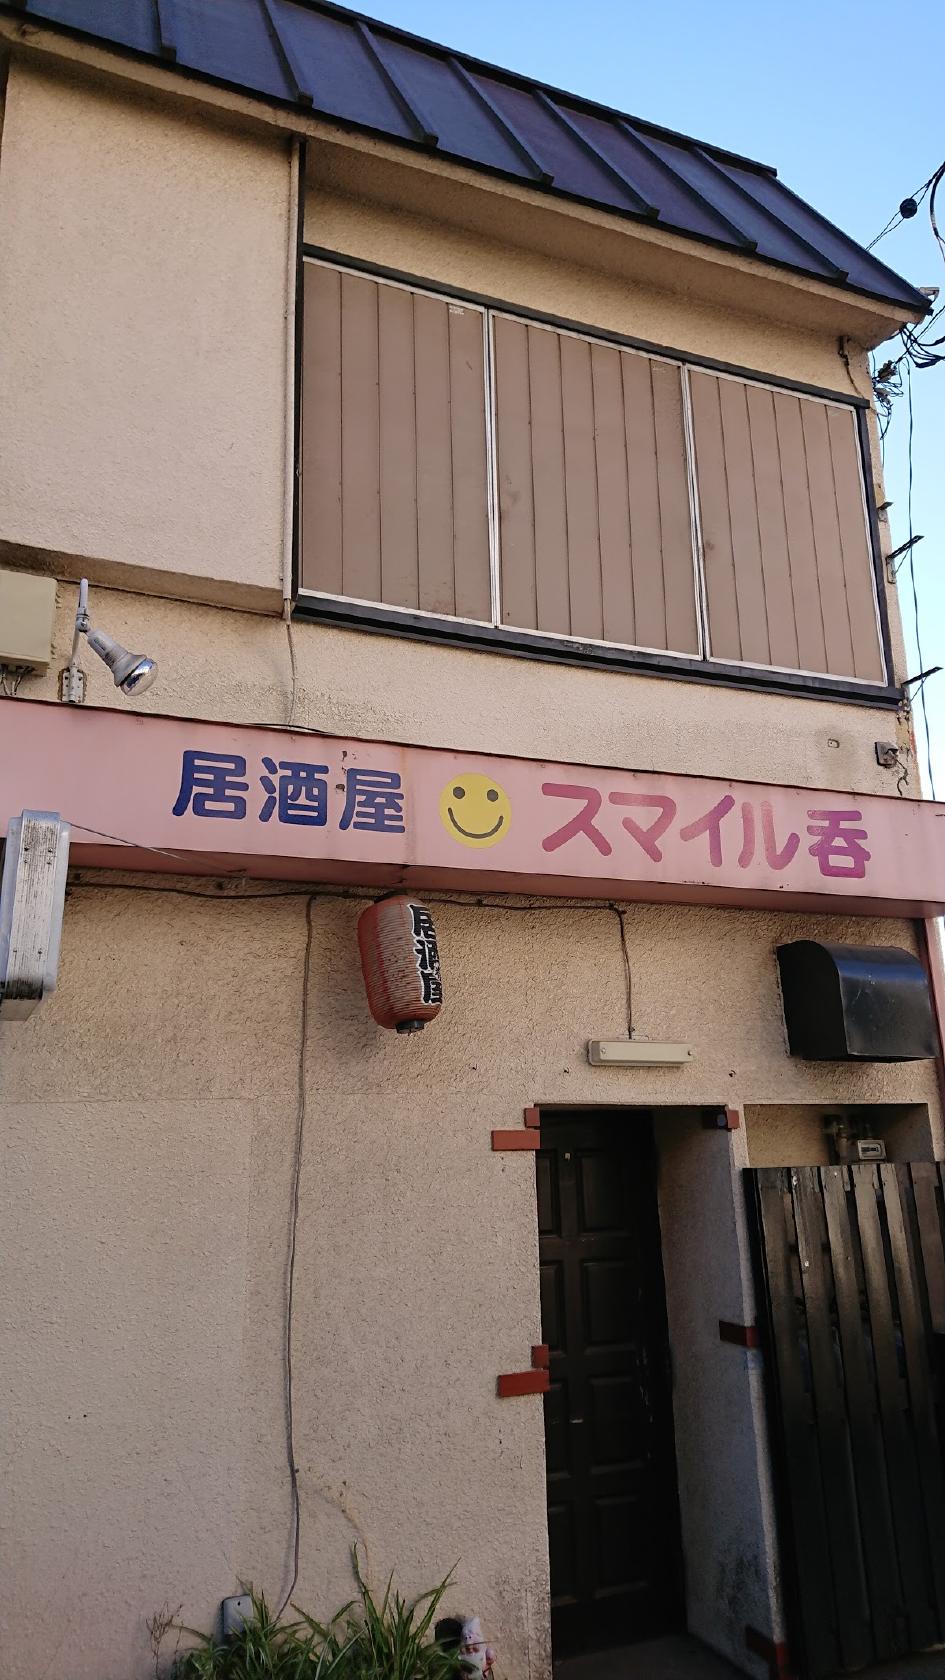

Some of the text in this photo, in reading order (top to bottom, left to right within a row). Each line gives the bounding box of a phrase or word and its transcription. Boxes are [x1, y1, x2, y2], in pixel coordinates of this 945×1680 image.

[172, 750, 872, 878] 居酒屋 スマイル呑
